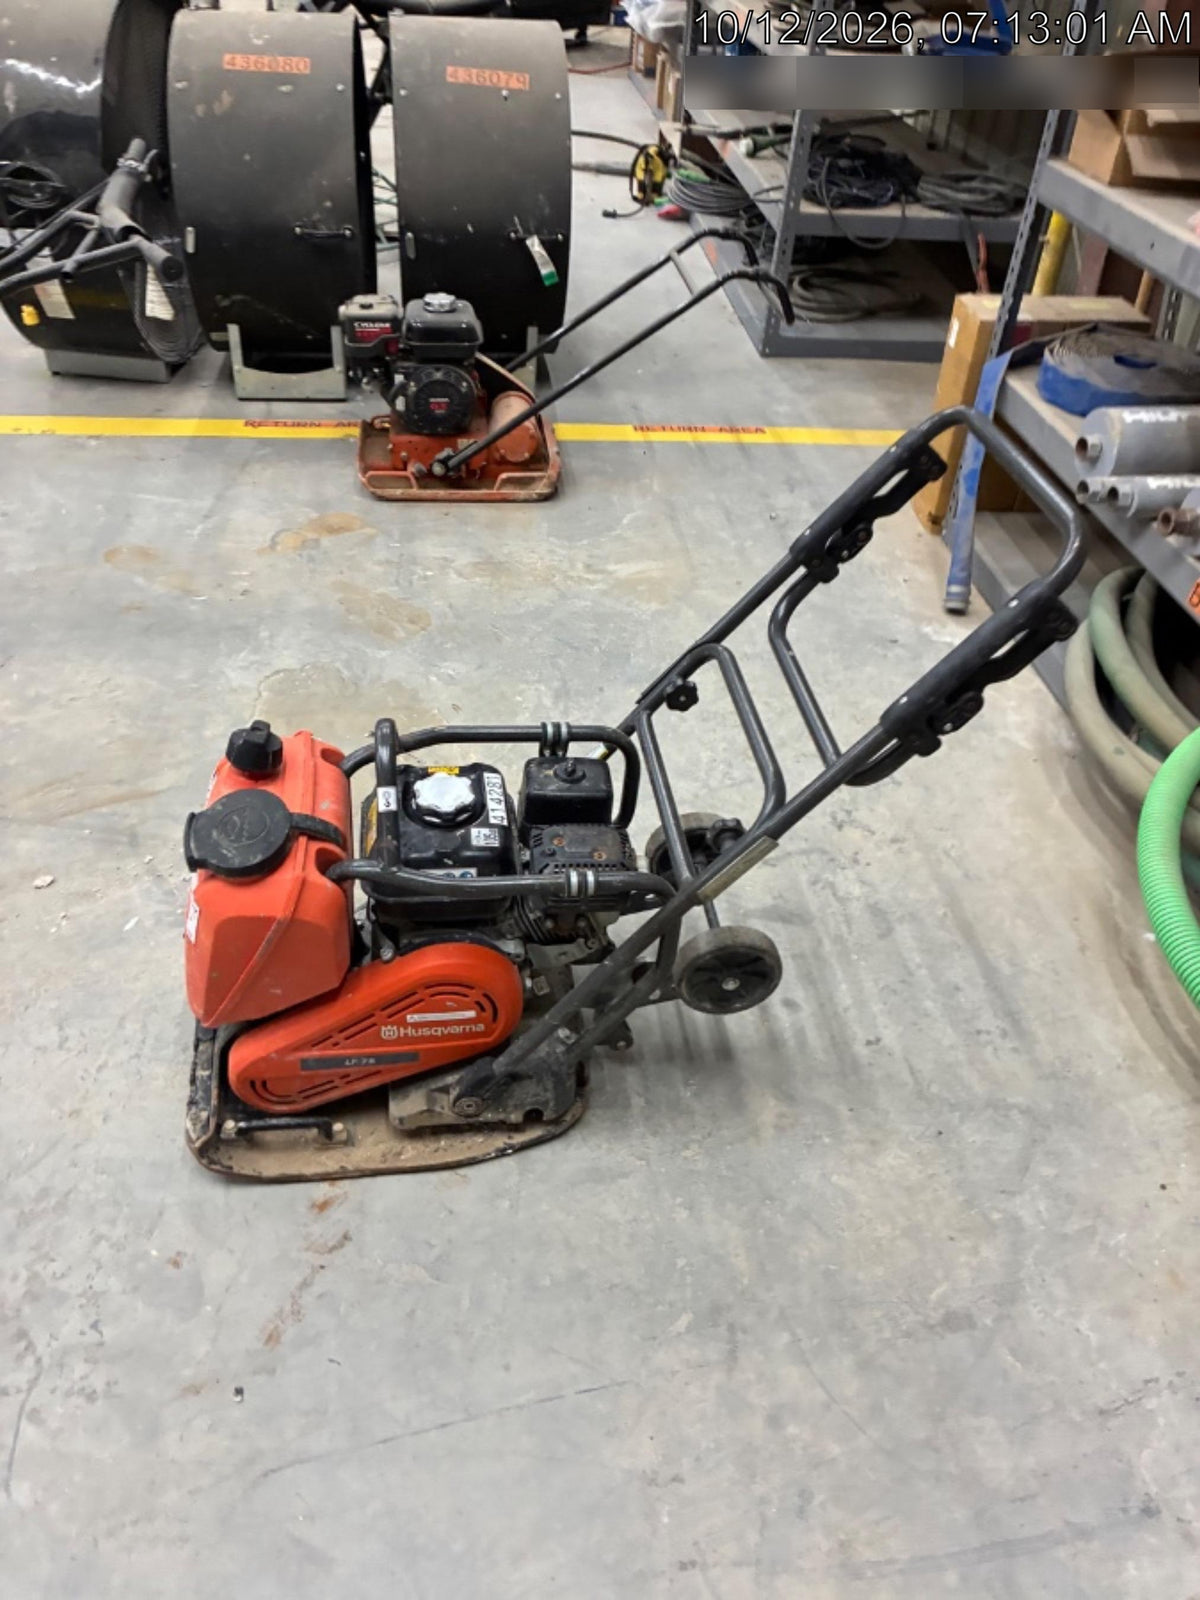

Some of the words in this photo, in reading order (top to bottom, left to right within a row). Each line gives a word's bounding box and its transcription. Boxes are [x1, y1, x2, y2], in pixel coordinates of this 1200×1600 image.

[224, 55, 310, 73] 436080
[447, 68, 528, 90] 436079
[486, 775, 505, 824] 414281
[400, 1023, 485, 1037] Husqvarna
